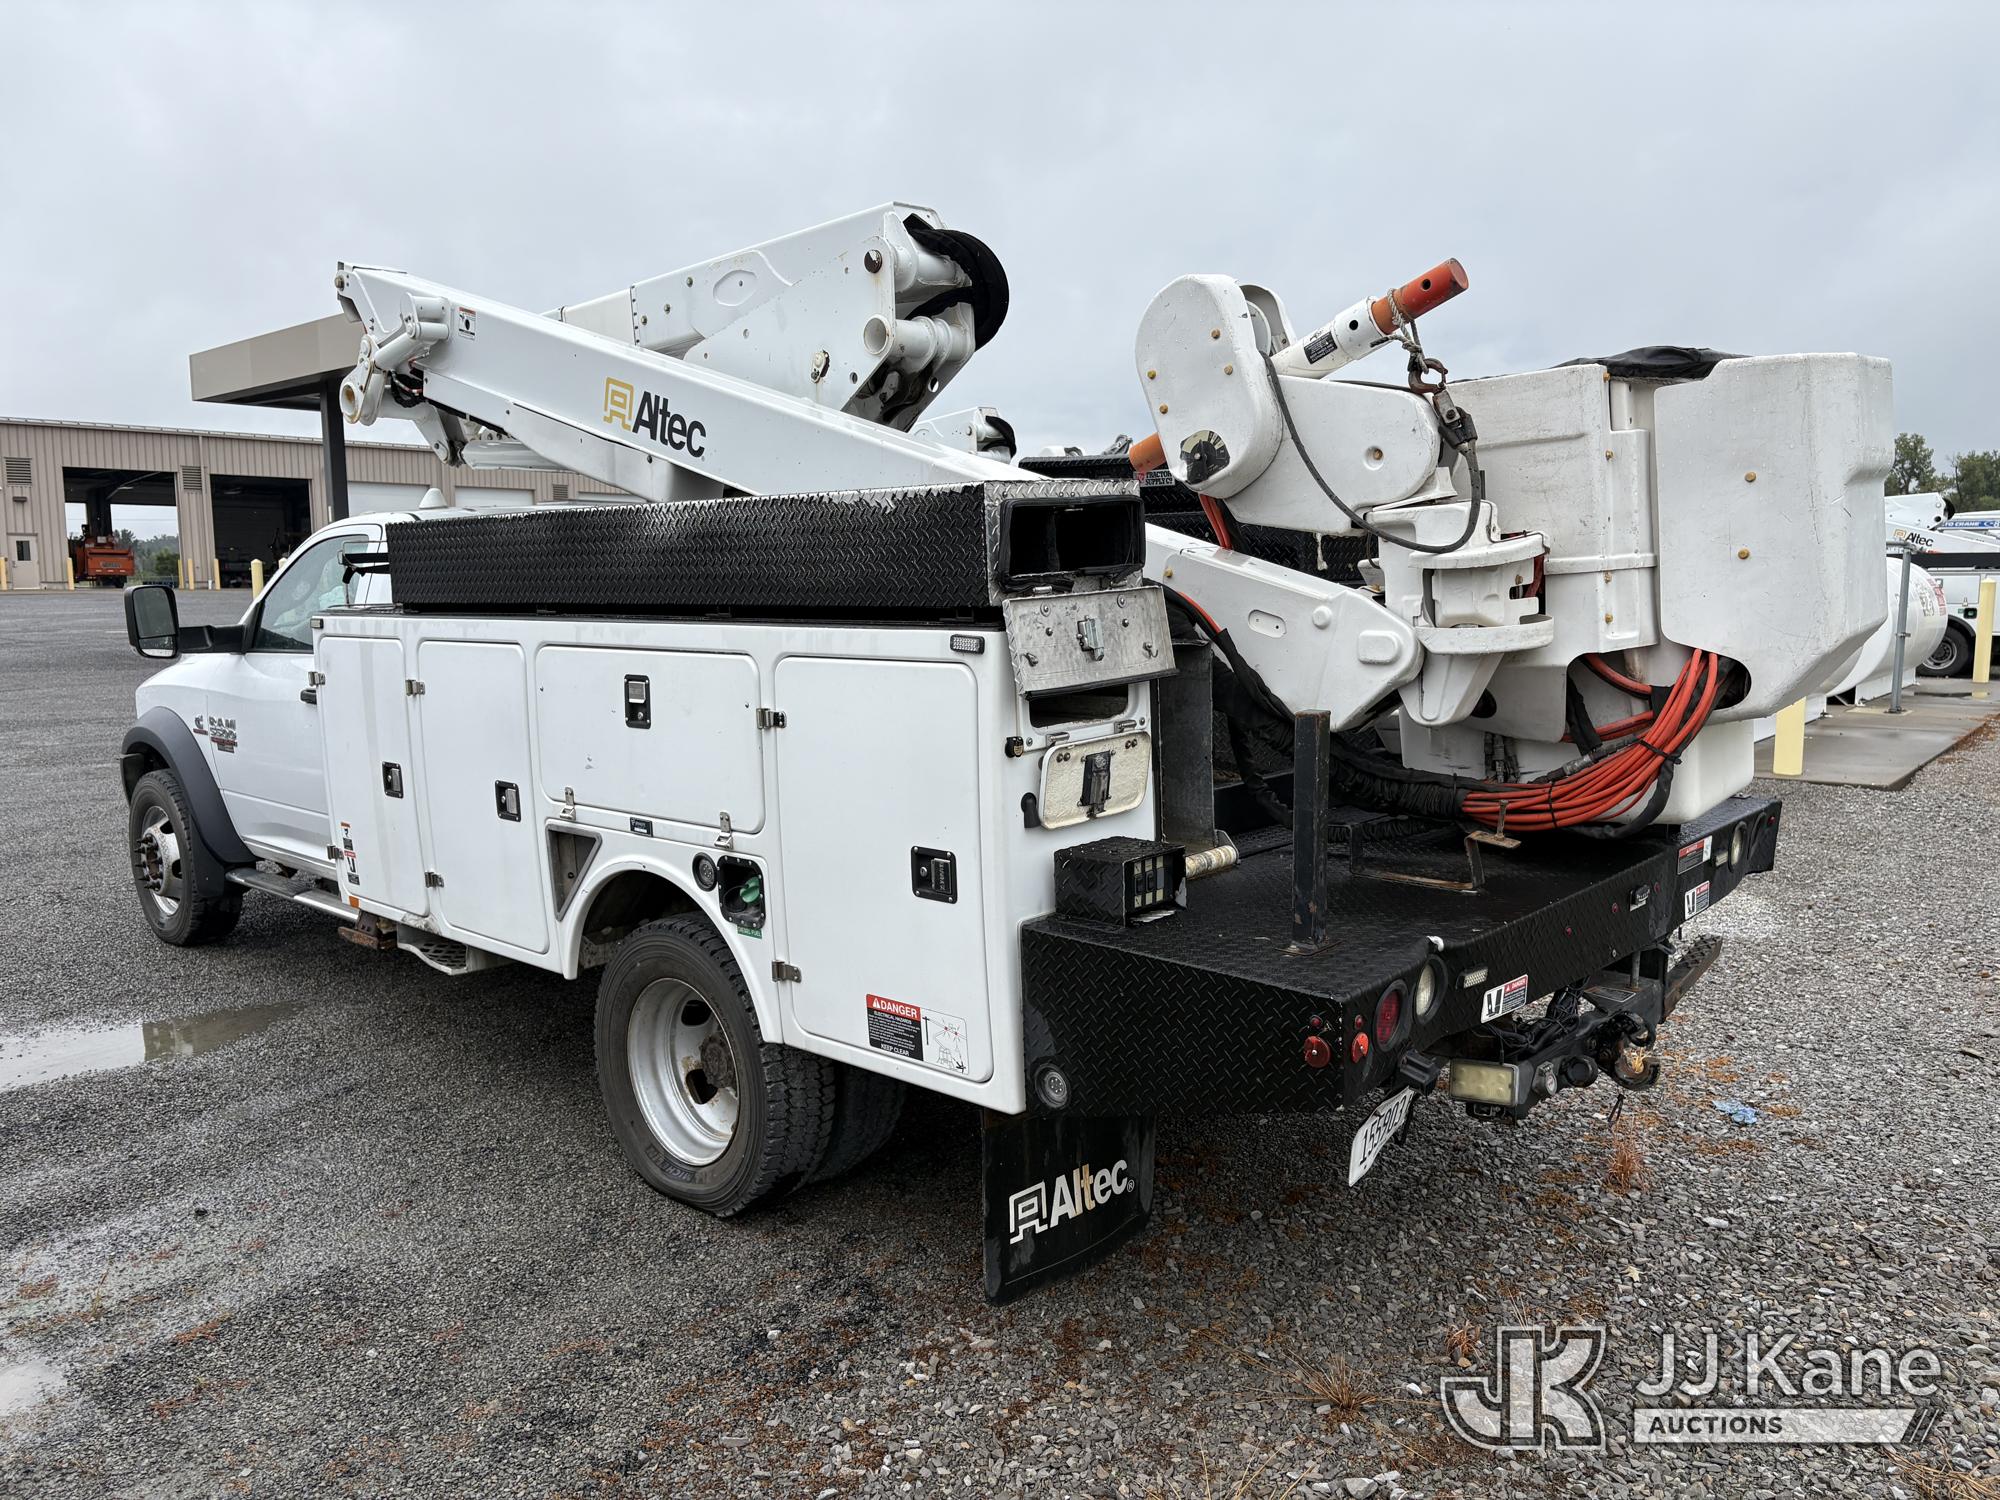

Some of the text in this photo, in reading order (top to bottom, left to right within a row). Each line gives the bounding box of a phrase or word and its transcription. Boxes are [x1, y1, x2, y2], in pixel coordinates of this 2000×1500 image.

[632, 391, 707, 458] Altec
[1145, 470, 1172, 479] TRACTOR
[1145, 478, 1166, 486] SUPPLY
[1905, 532, 1934, 547] Altec
[209, 716, 236, 730] RAM
[880, 1000, 918, 1019] DANGER
[880, 1043, 910, 1056] KEEP CLEAR
